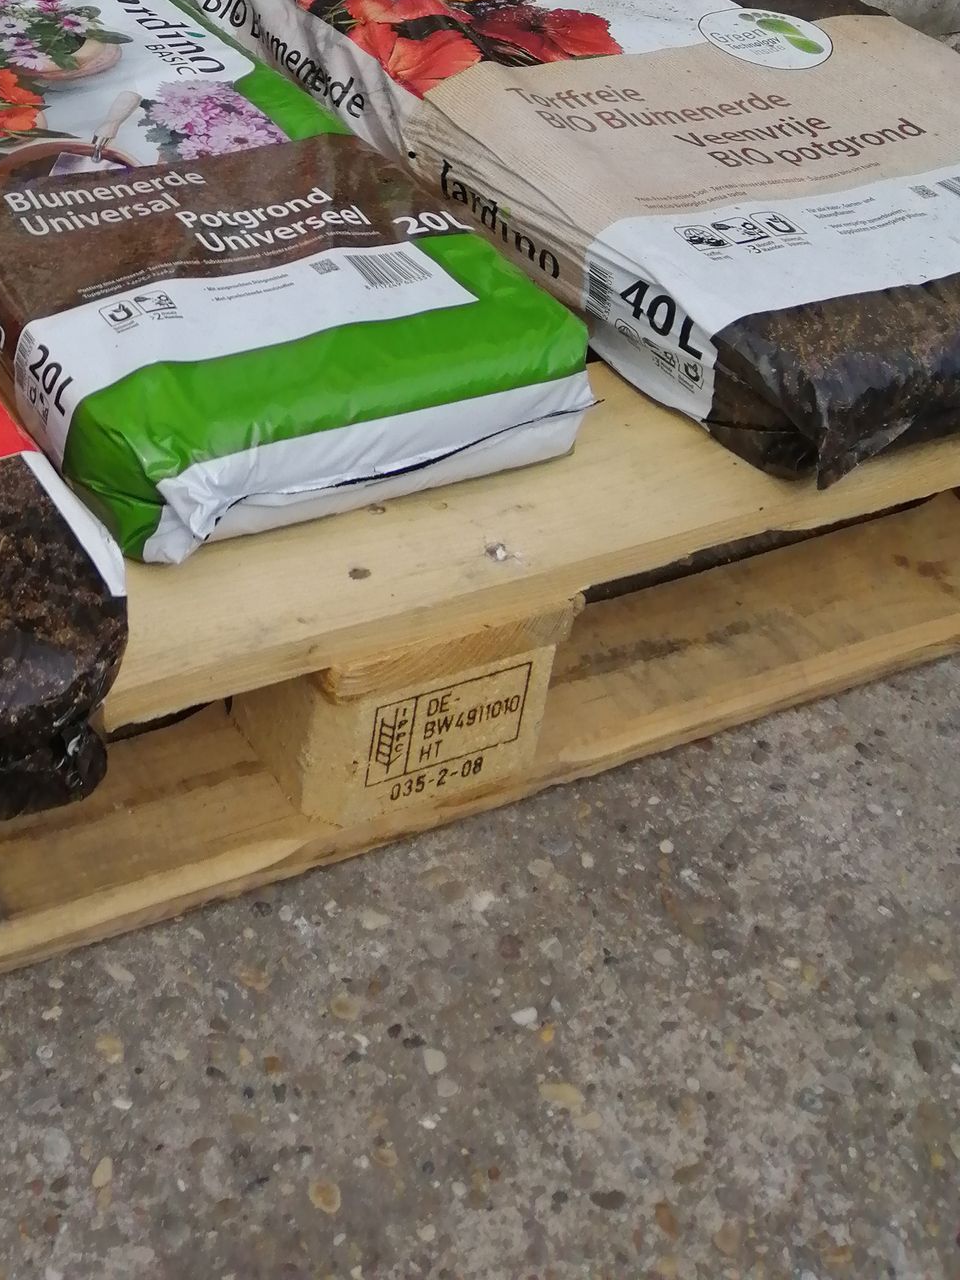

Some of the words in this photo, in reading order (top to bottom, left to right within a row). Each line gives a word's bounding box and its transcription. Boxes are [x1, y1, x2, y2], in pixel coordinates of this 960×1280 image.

[709, 27, 768, 44] Green
[725, 36, 781, 51] Technology
[145, 43, 198, 76] BASIC
[504, 85, 646, 111] Torffreie
[534, 109, 599, 133] BIO
[594, 91, 793, 131] Blumenerde
[671, 113, 833, 149] Veenvrije
[706, 146, 775, 168] BIO
[773, 116, 929, 168] potgrond
[3, 167, 207, 213] Blumenerde
[174, 187, 333, 232] Potgrond
[19, 193, 182, 237] Universal
[194, 205, 372, 254] Universeel
[392, 210, 476, 235] 20L
[441, 157, 560, 280] Jardino
[619, 279, 703, 361] 40L
[28, 343, 74, 417] 20L
[419, 740, 444, 764] HT
[390, 756, 484, 801] 035-2-08
